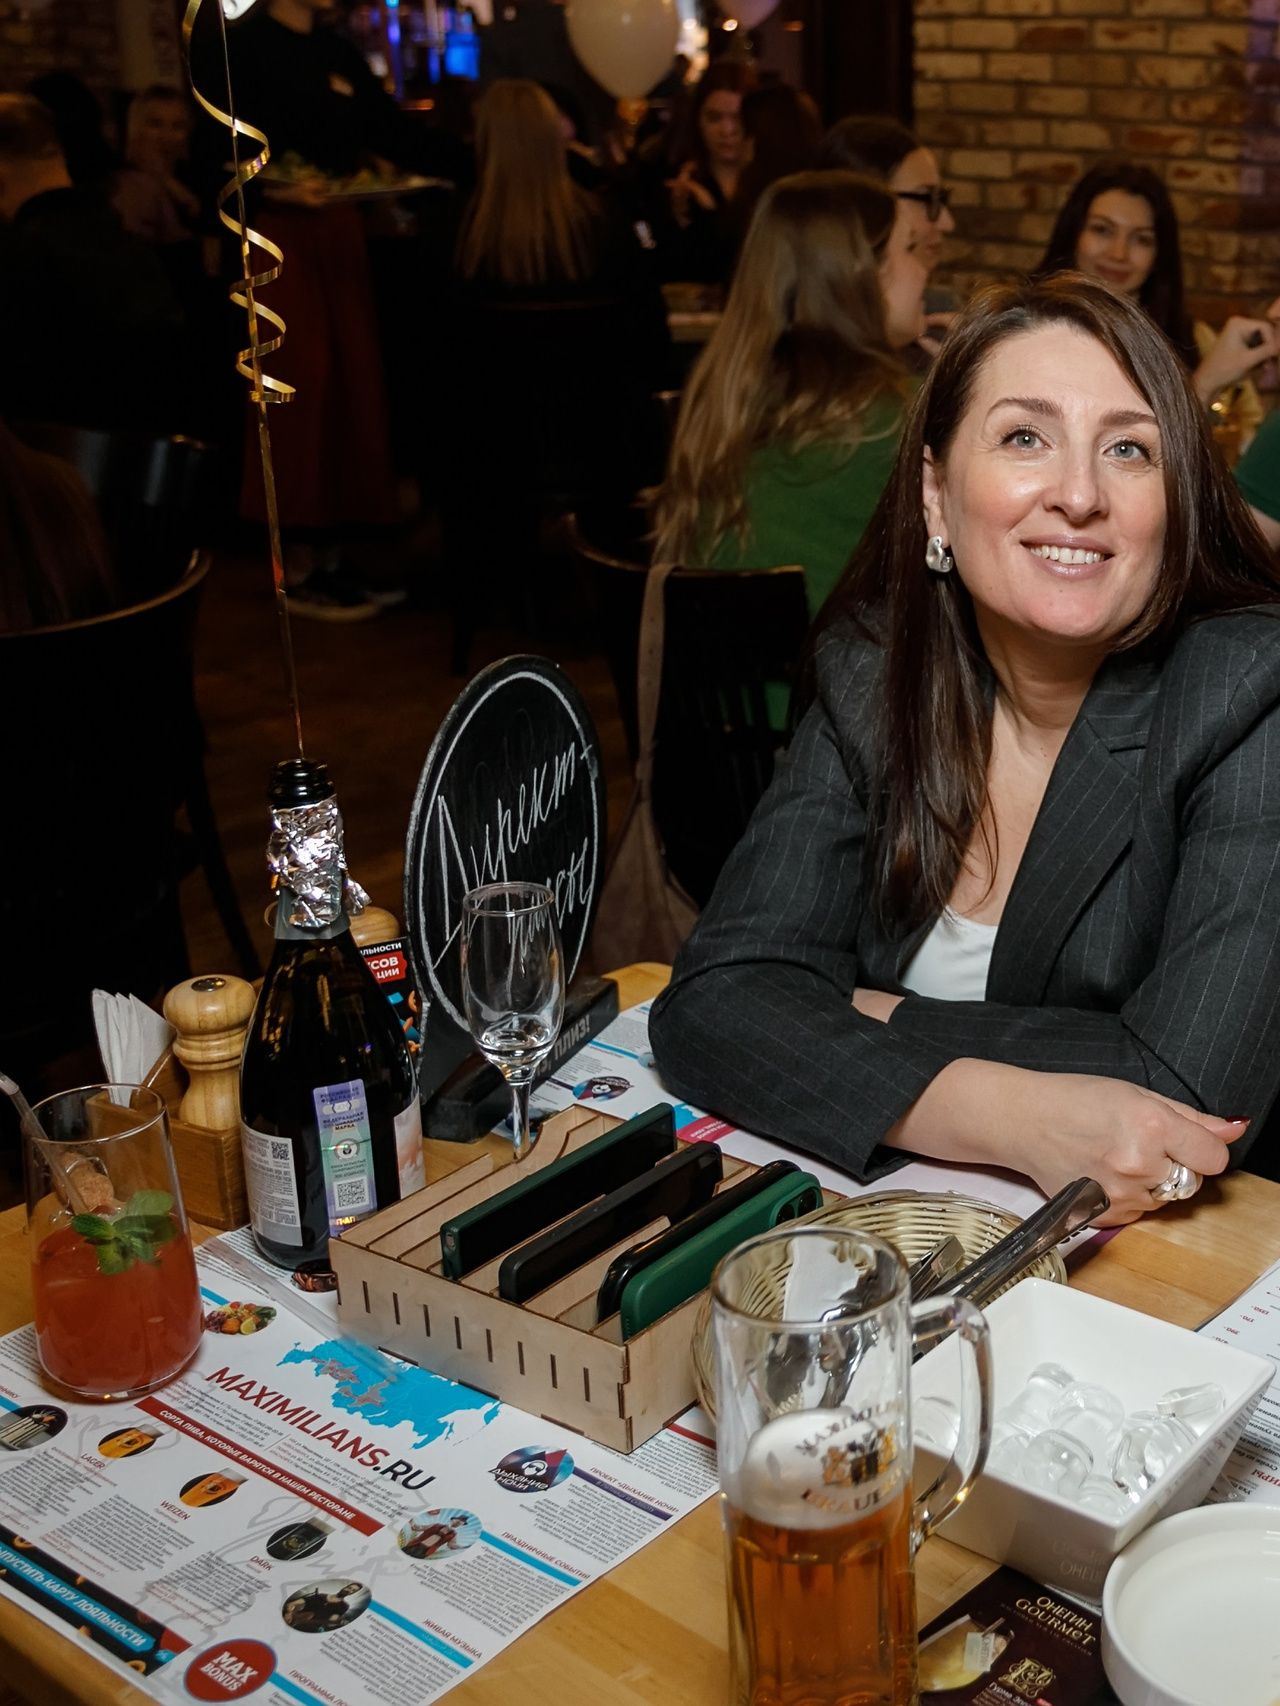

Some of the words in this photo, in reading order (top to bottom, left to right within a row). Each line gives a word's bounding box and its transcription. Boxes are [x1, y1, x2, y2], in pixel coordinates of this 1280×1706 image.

[368, 956, 399, 970] СОВ
[554, 1014, 591, 1061] ПЛИЗ!
[334, 1123, 356, 1131] МАРКА
[80, 1452, 107, 1470] LAGER
[157, 1409, 186, 1426] СОРТА
[179, 1421, 208, 1439] ПИВА,
[202, 1433, 244, 1458] КОТОРЫЕ
[237, 1452, 276, 1475] ВАРЯТСЯ
[277, 1474, 311, 1494] НАШЕМ
[306, 1489, 357, 1520] РЕСТОРАНЕ
[587, 1466, 619, 1483] ПРОЕКТ
[158, 1499, 191, 1521] WEIZEN
[248, 1554, 275, 1571] DARK
[499, 1531, 557, 1562] ПРАЗДНИЧНЫЕ
[552, 1558, 591, 1580] СОБЫТИЯ
[40, 1577, 80, 1602] КАРТУ
[69, 1598, 148, 1647] ЛОЯЛЬНОСТИ
[1037, 1596, 1093, 1631] ОНЕГИН
[420, 1618, 454, 1638] ЖИВАЯ
[447, 1635, 485, 1658] МУЗЫКА
[200, 1662, 244, 1693] BONUS
[212, 1650, 258, 1682] MAX
[289, 1669, 335, 1702] ПРОГРАММА
